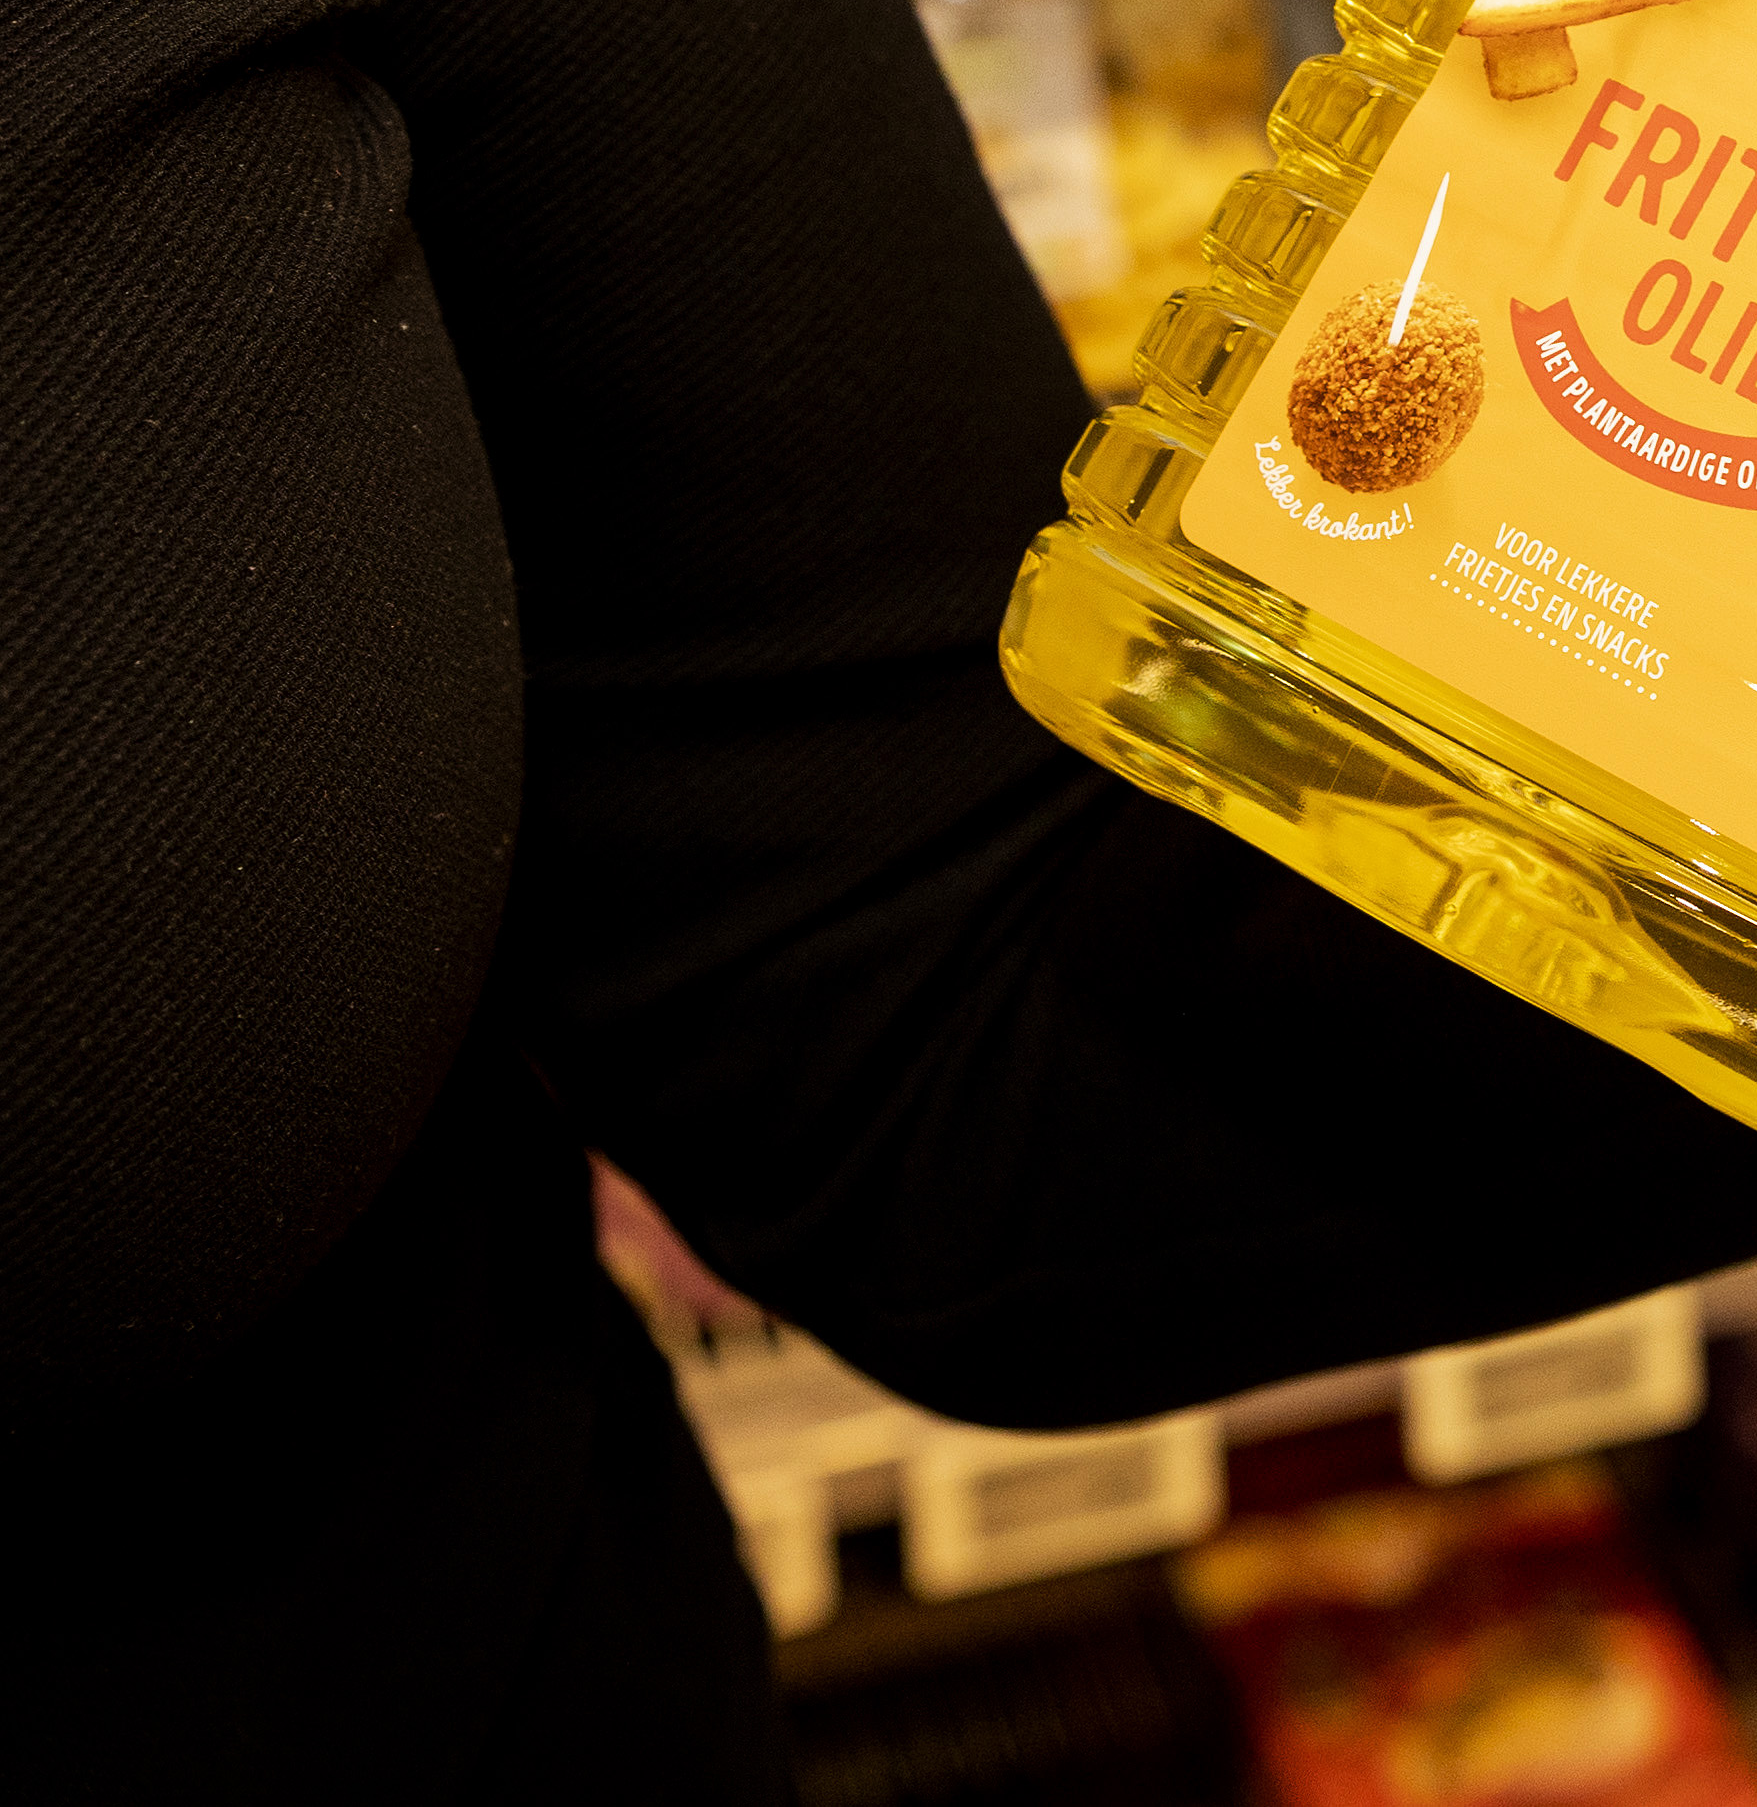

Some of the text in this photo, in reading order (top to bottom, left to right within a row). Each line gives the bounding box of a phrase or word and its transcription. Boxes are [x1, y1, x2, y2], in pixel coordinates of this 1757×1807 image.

[1535, 329, 1579, 383] MET
[1561, 375, 1732, 486] PLANTAARDIGE
[1254, 435, 1415, 541] Lekker krokant!
[1443, 541, 1671, 681] FRIETJES EN SNACKS
[1494, 521, 1660, 630] VOOR LEKKERE
